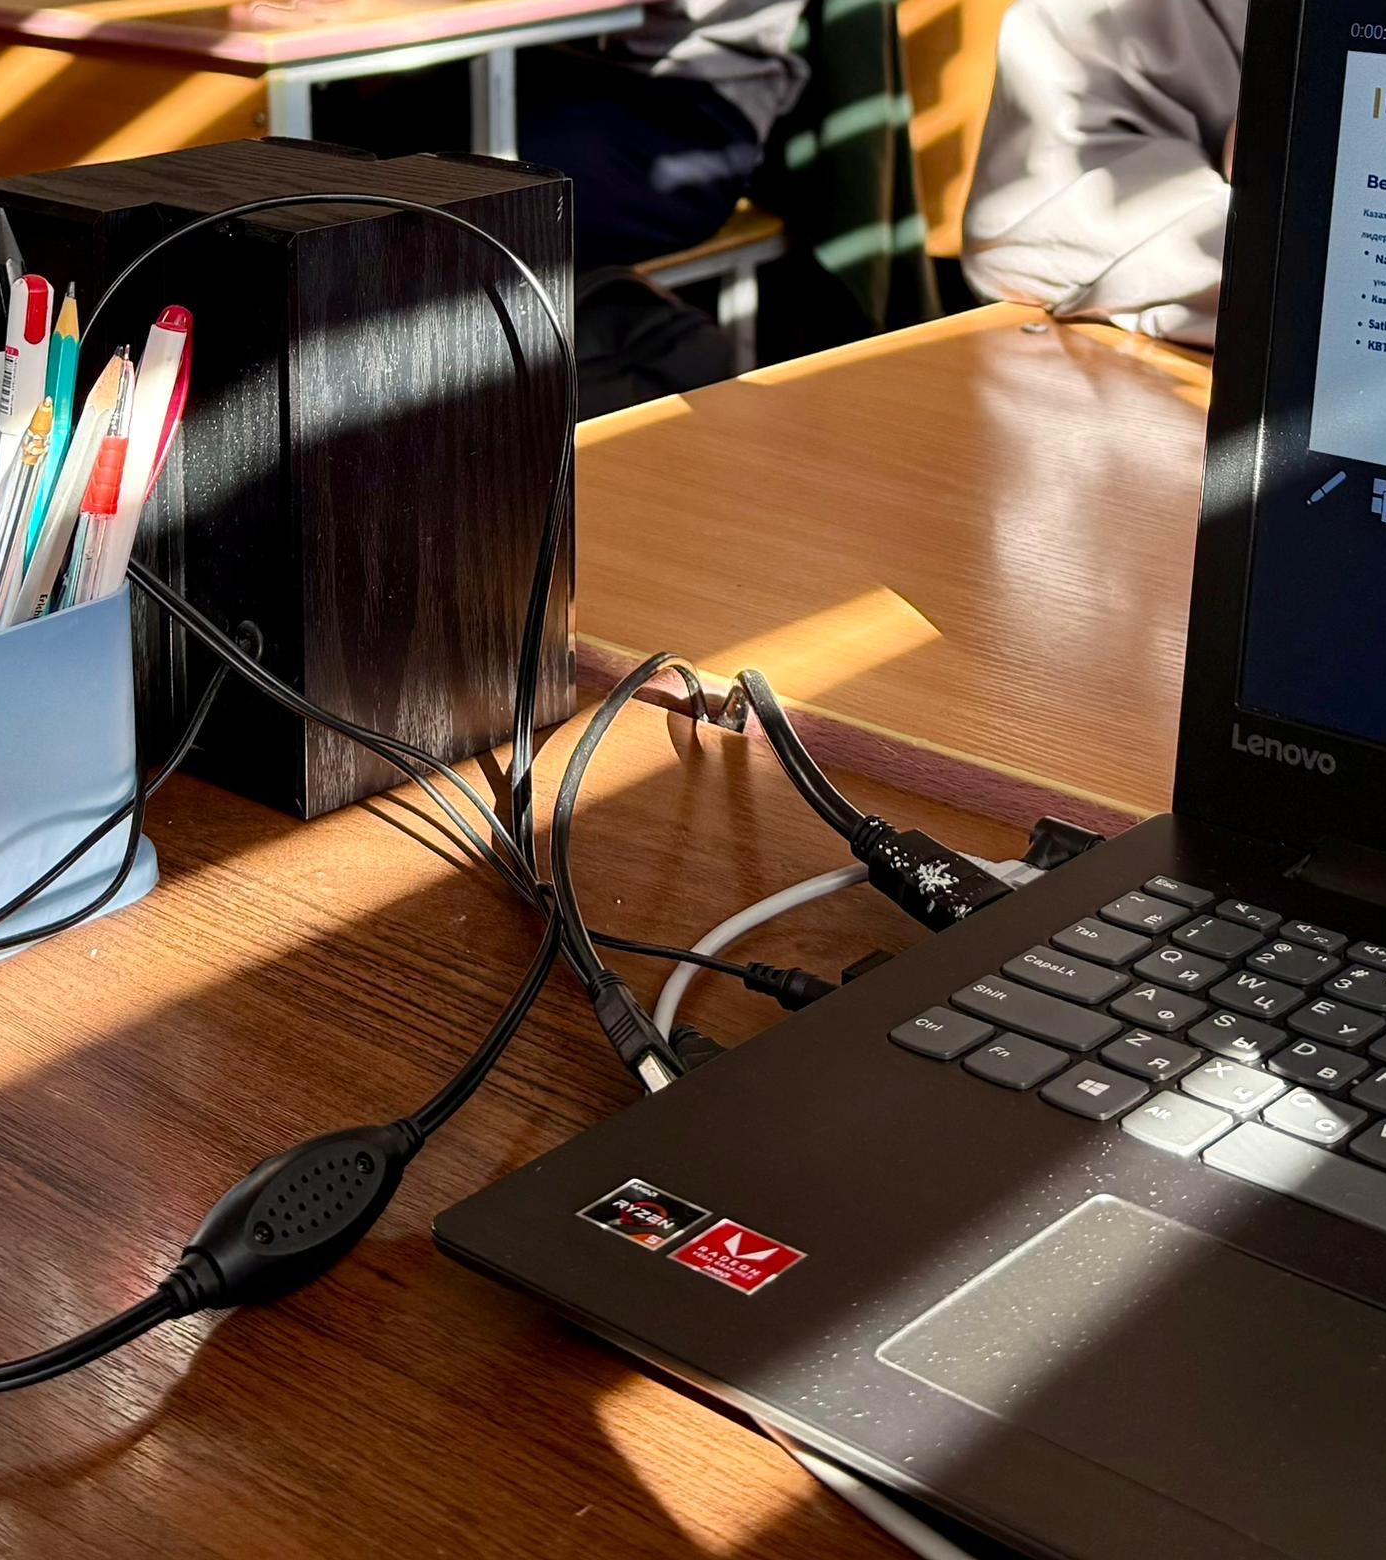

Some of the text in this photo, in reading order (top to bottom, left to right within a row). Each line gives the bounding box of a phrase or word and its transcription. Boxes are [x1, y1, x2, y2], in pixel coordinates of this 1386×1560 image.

[1232, 723, 1336, 775] Lenovo
[1155, 878, 1178, 890] Esc
[1074, 926, 1098, 938] Tab
[1023, 954, 1076, 977] CapsLk
[973, 984, 1007, 1000] Shift
[915, 1018, 943, 1032] Ctrl
[989, 1046, 1010, 1058] Fn
[1144, 1106, 1171, 1120] Alt
[613, 1199, 675, 1229] RYZEN
[698, 1246, 761, 1276] RADEON
